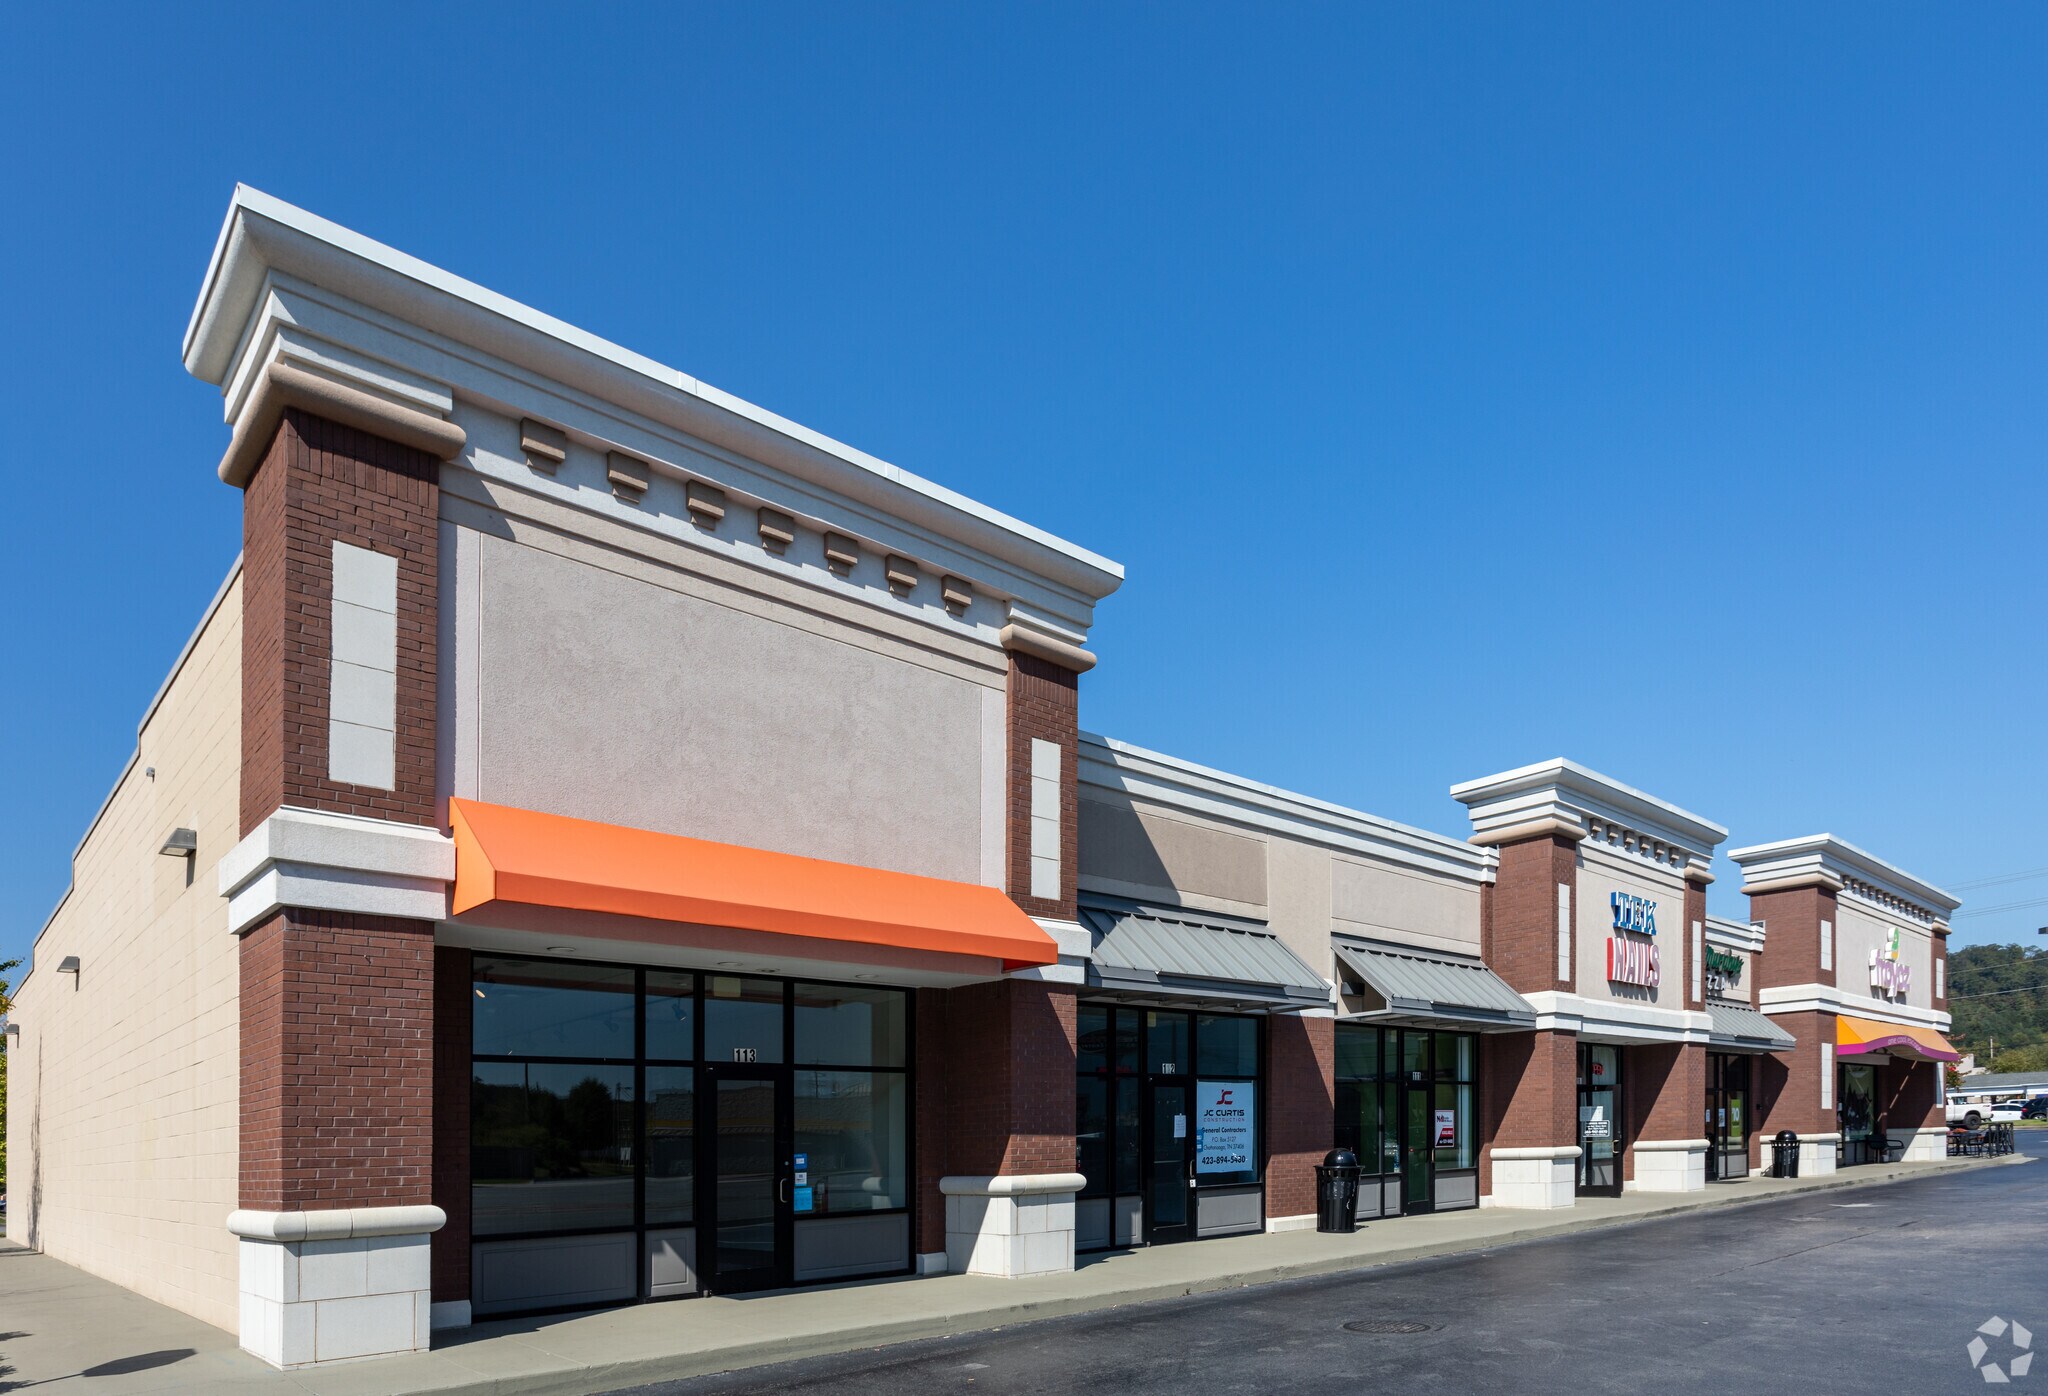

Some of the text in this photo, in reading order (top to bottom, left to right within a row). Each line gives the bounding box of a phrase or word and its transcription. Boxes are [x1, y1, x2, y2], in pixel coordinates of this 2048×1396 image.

[1611, 891, 1657, 935] TEK
[1607, 937, 1661, 988] NAILS
[1707, 974, 1726, 991] ZZA
[735, 1048, 756, 1062] 113
[1203, 1109, 1245, 1117] JC CURTIS
